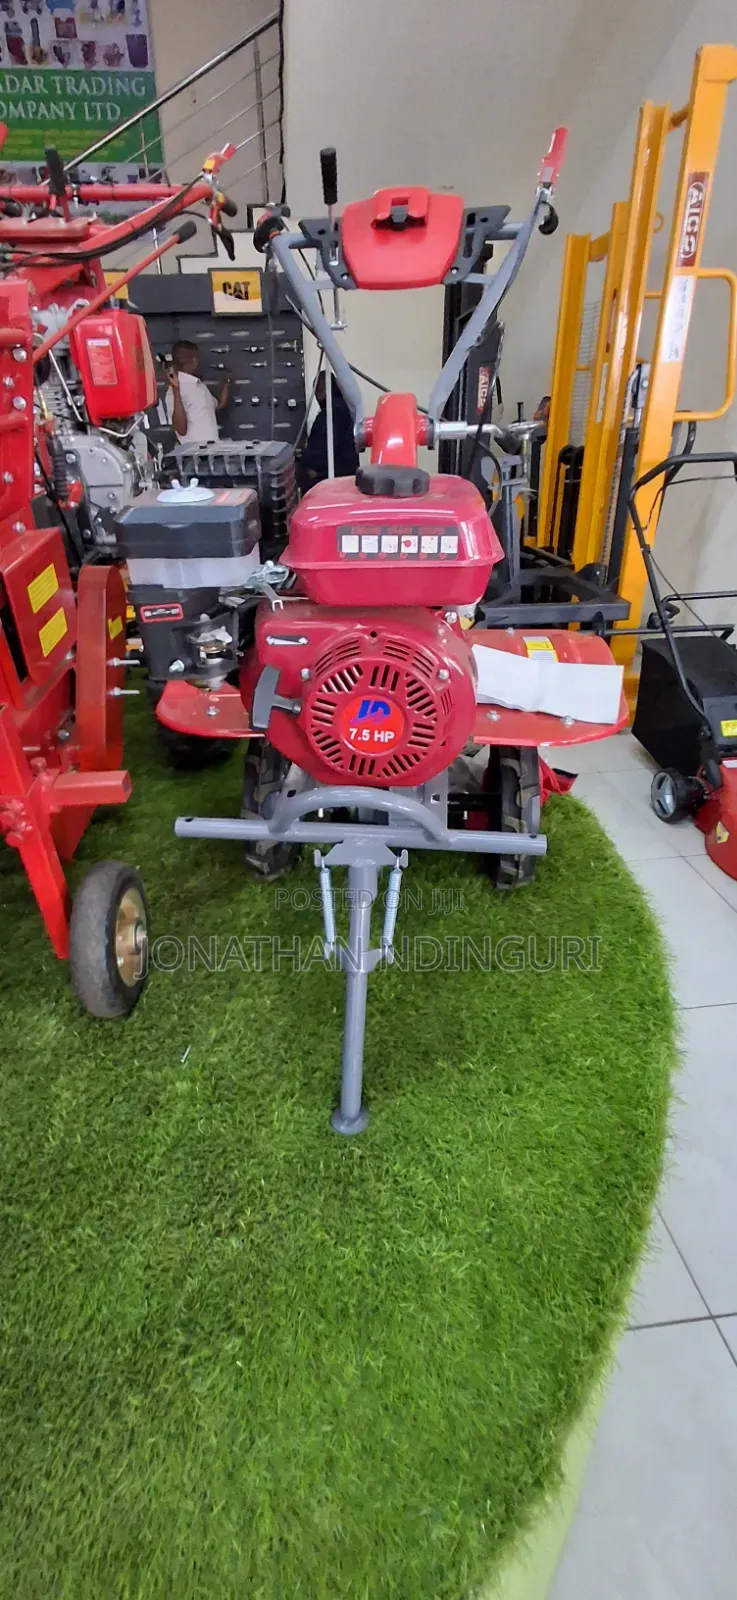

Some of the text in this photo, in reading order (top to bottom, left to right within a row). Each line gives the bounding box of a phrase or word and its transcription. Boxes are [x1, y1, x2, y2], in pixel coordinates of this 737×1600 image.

[0, 75, 146, 96] DAR TRADING
[84, 102, 121, 121] LTD
[222, 281, 251, 300] CAT
[349, 727, 395, 743] 7.5 HP
